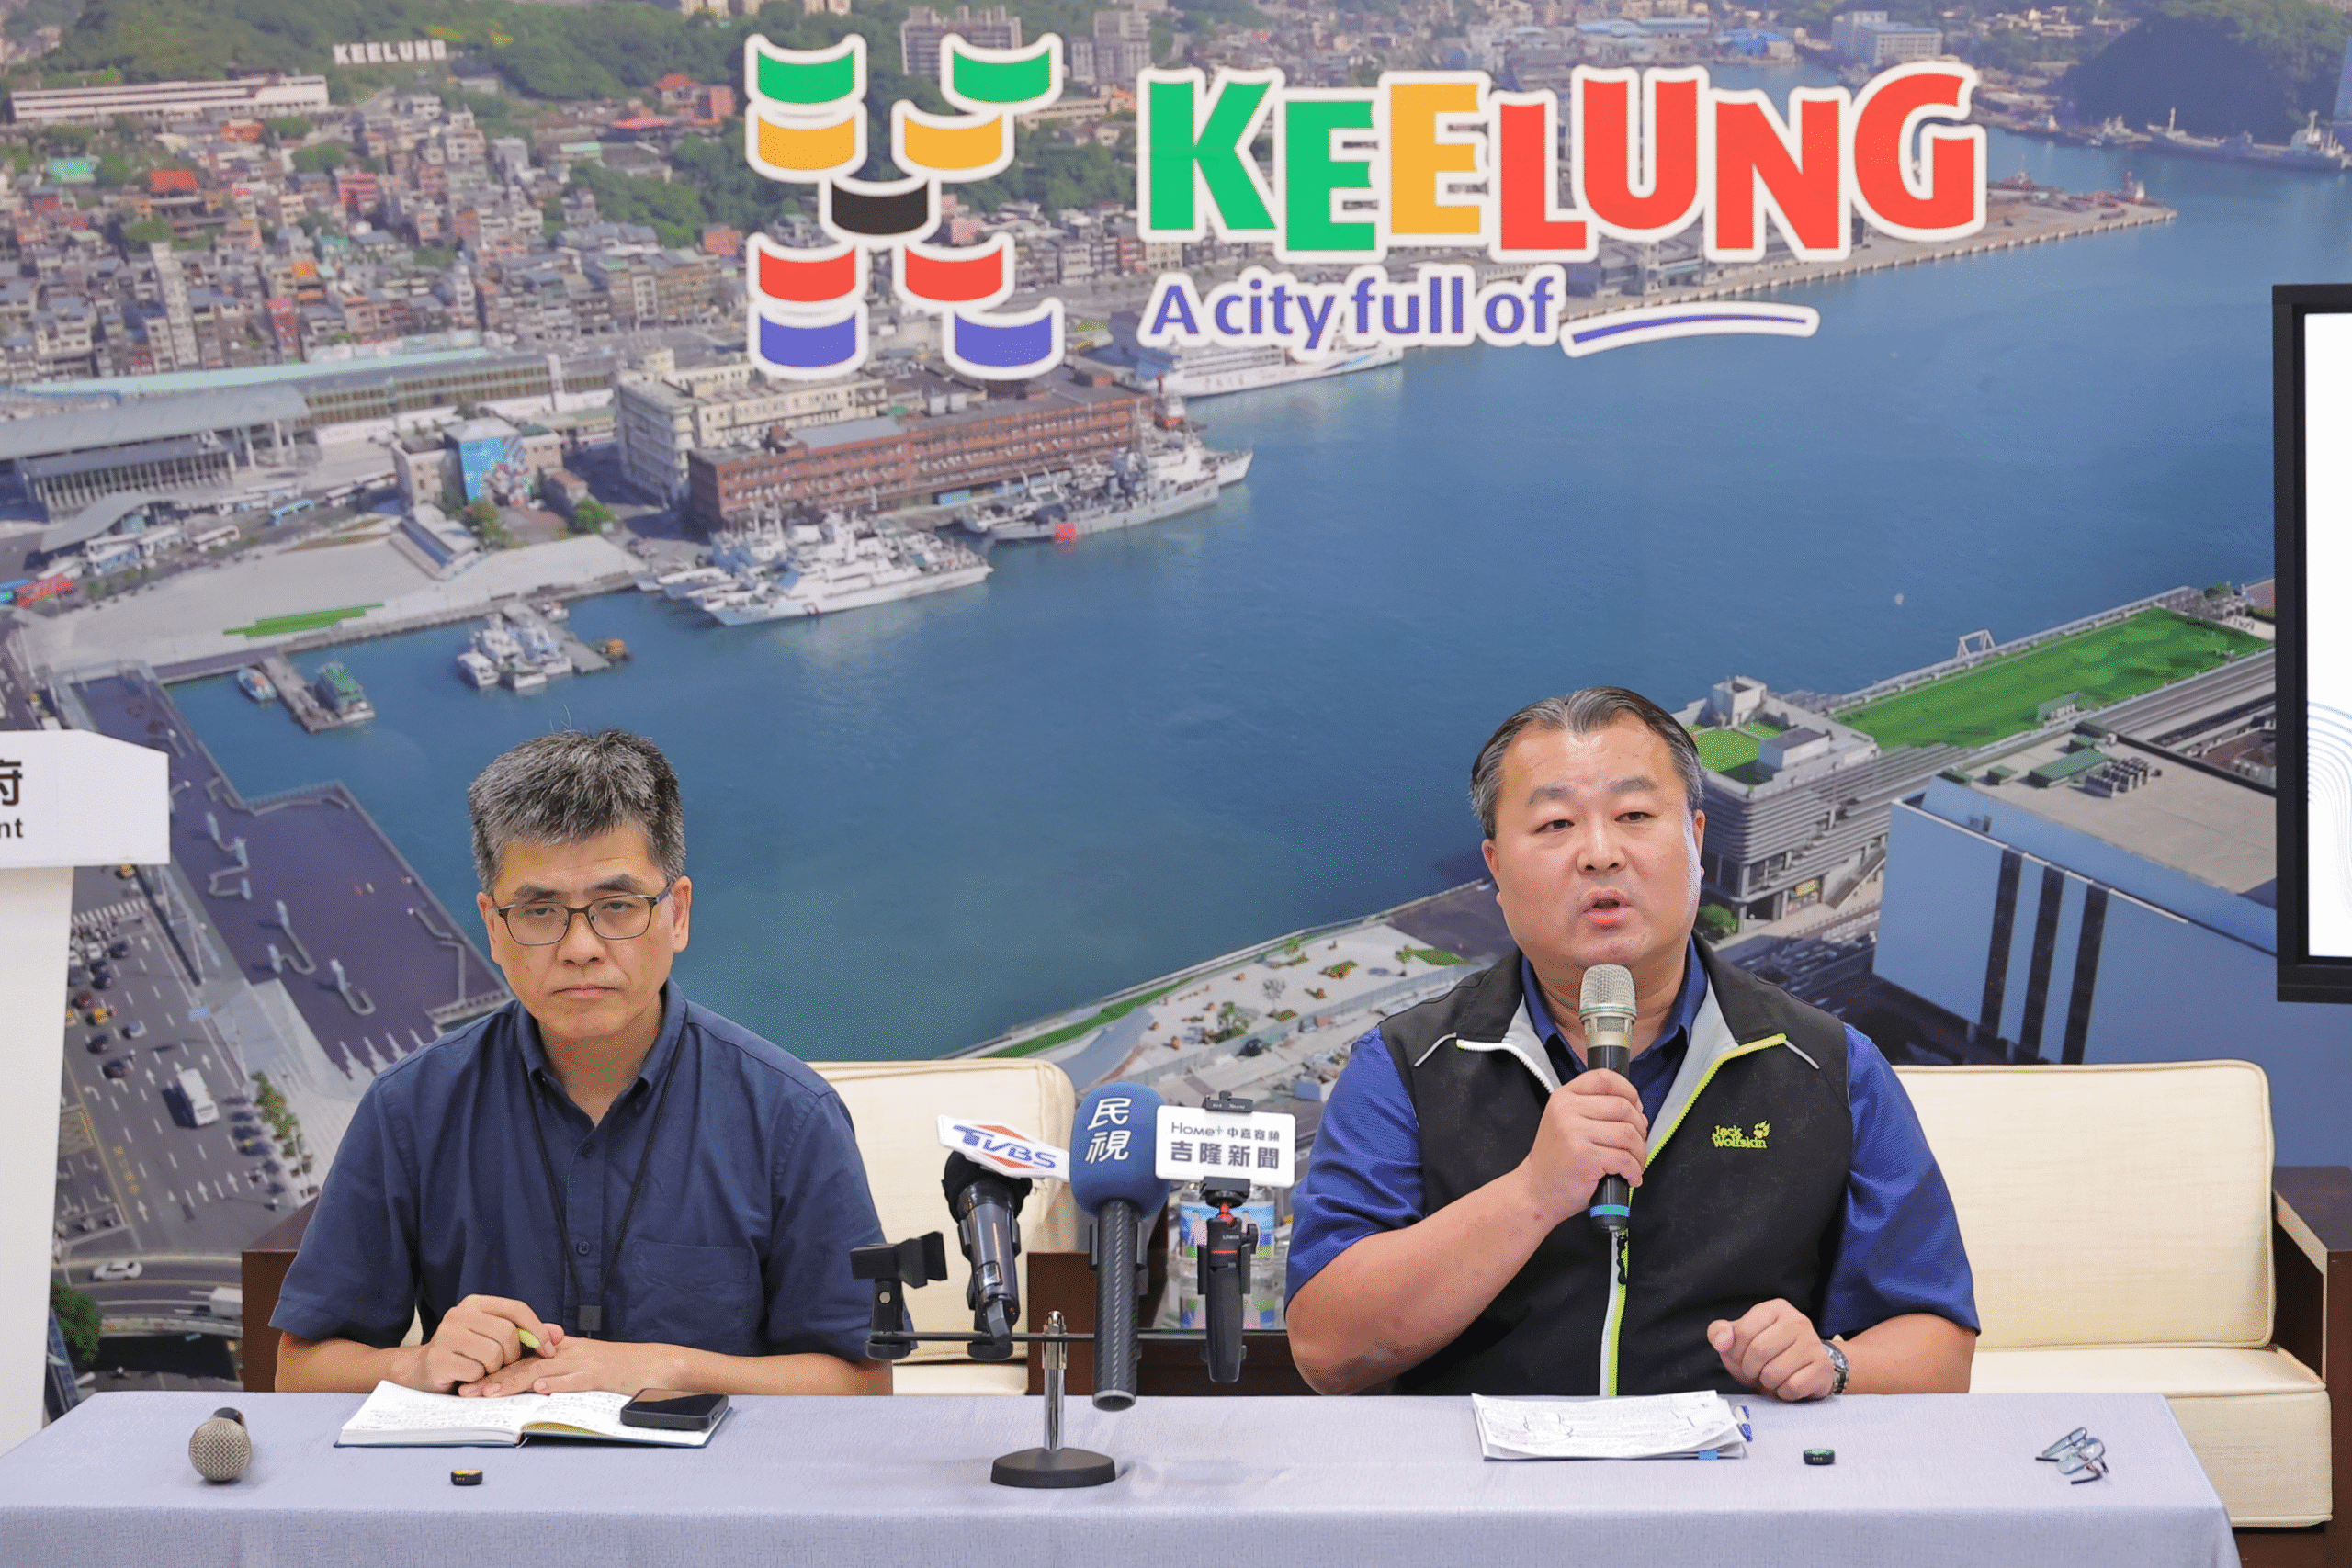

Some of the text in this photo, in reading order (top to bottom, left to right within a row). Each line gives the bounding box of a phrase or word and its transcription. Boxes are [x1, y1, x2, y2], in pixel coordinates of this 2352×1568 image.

[1148, 72, 1977, 252] KEELUNG
[1150, 276, 1555, 350] A city full of
[952, 1124, 1057, 1168] TVBS
[1085, 1097, 1132, 1164] 民視
[1170, 1140, 1280, 1169] 吉隆新聞
